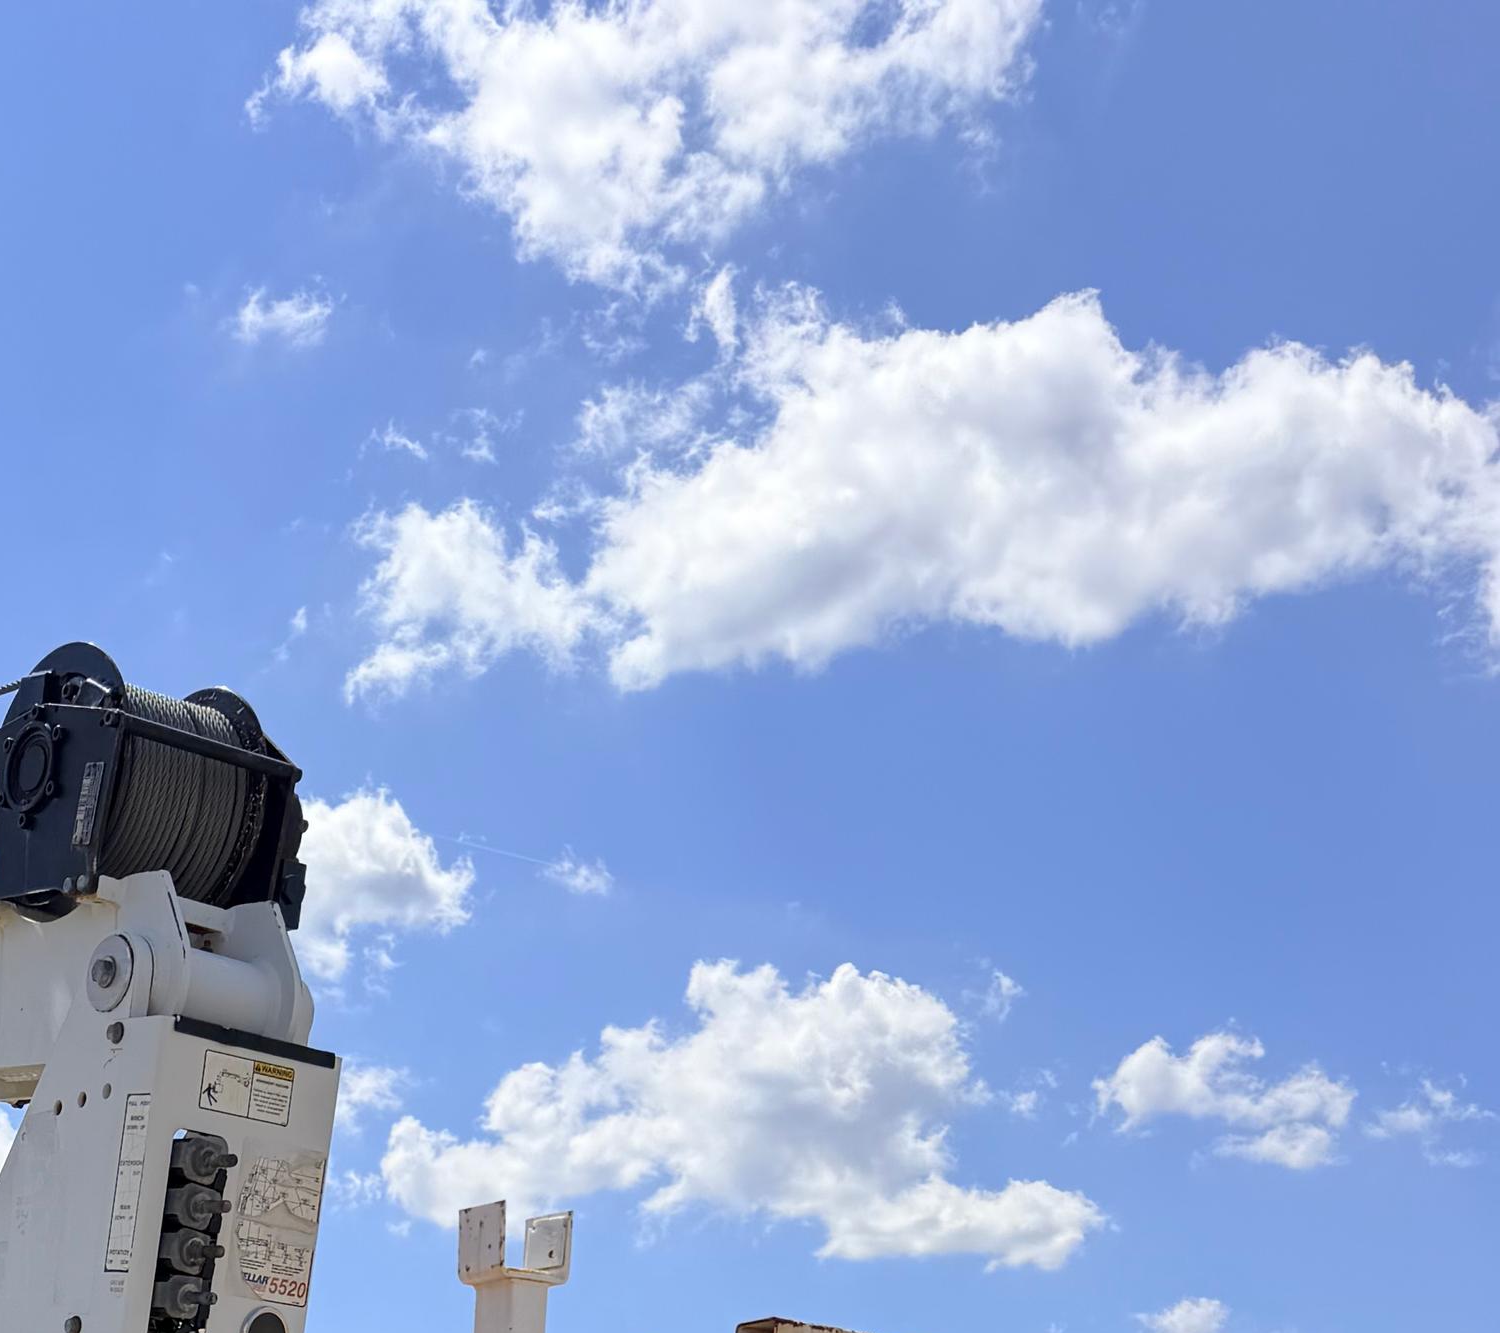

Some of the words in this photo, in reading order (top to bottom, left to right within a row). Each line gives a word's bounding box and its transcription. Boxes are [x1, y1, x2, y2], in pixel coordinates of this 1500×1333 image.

[261, 1065, 293, 1079] WARNING
[243, 1272, 269, 1285] ELLAR
[268, 1277, 307, 1298] 5520
